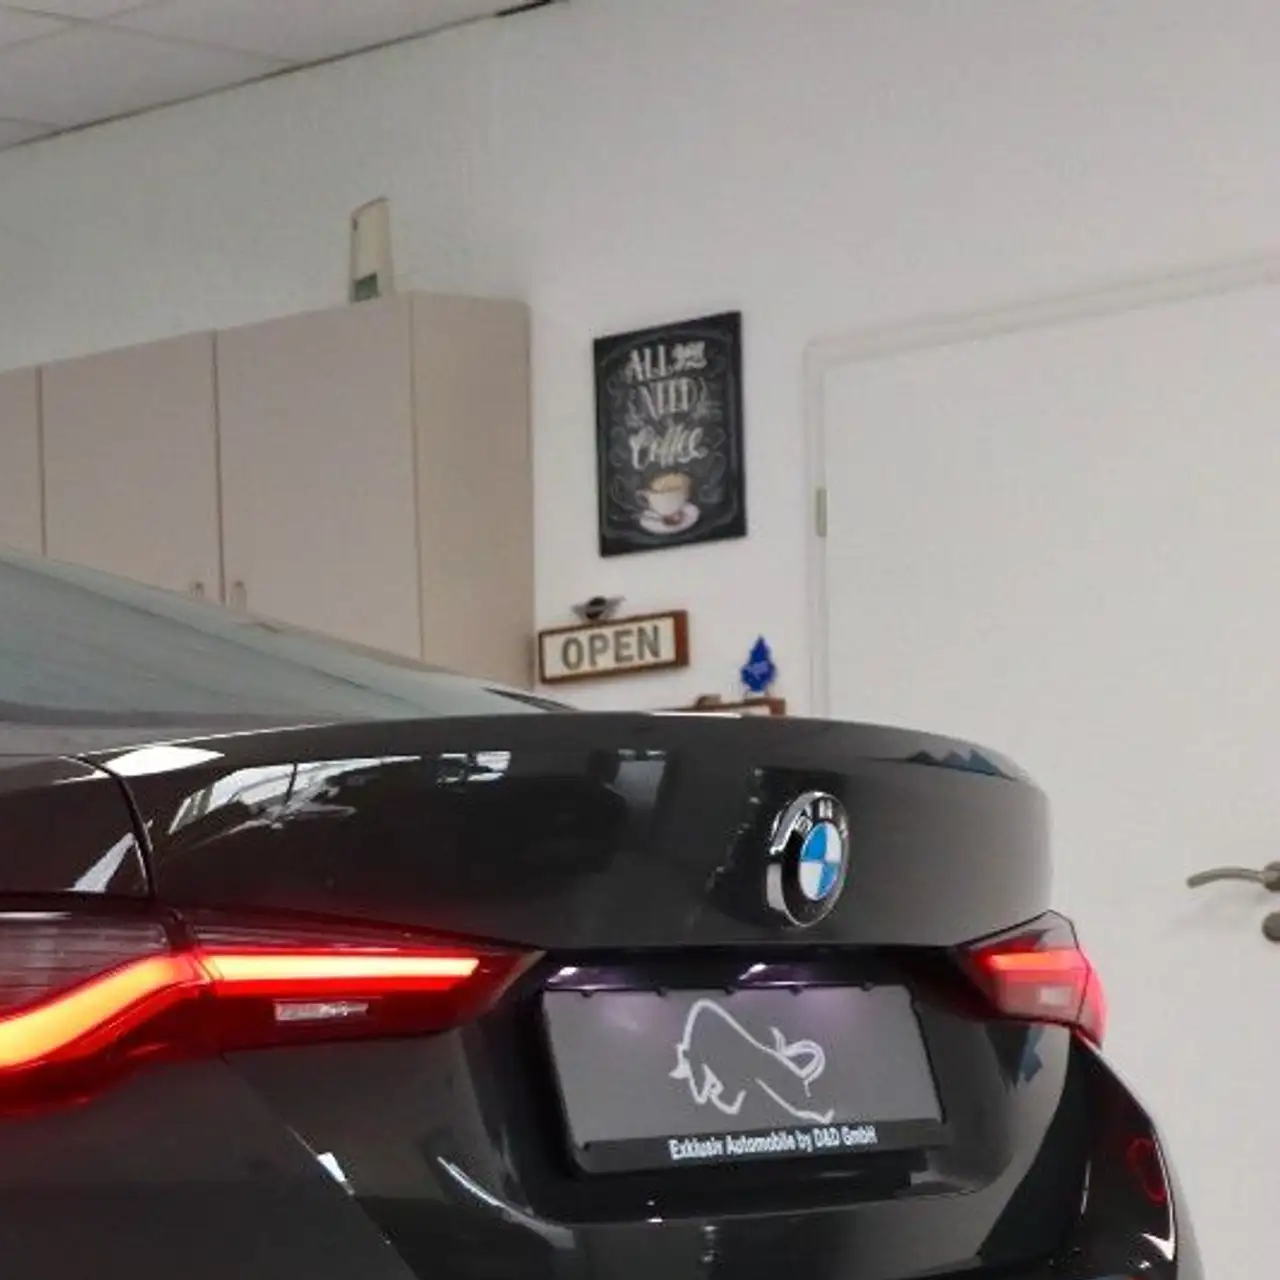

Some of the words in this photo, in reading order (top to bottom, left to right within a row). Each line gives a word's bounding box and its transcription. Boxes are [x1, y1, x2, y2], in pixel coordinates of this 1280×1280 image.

[625, 345, 672, 383] ALL
[562, 624, 660, 670] OPEN
[668, 1137, 724, 1160] Exklusiv
[725, 1131, 796, 1154] Automobile
[795, 1130, 813, 1152] by
[841, 1124, 877, 1145] GmbH
